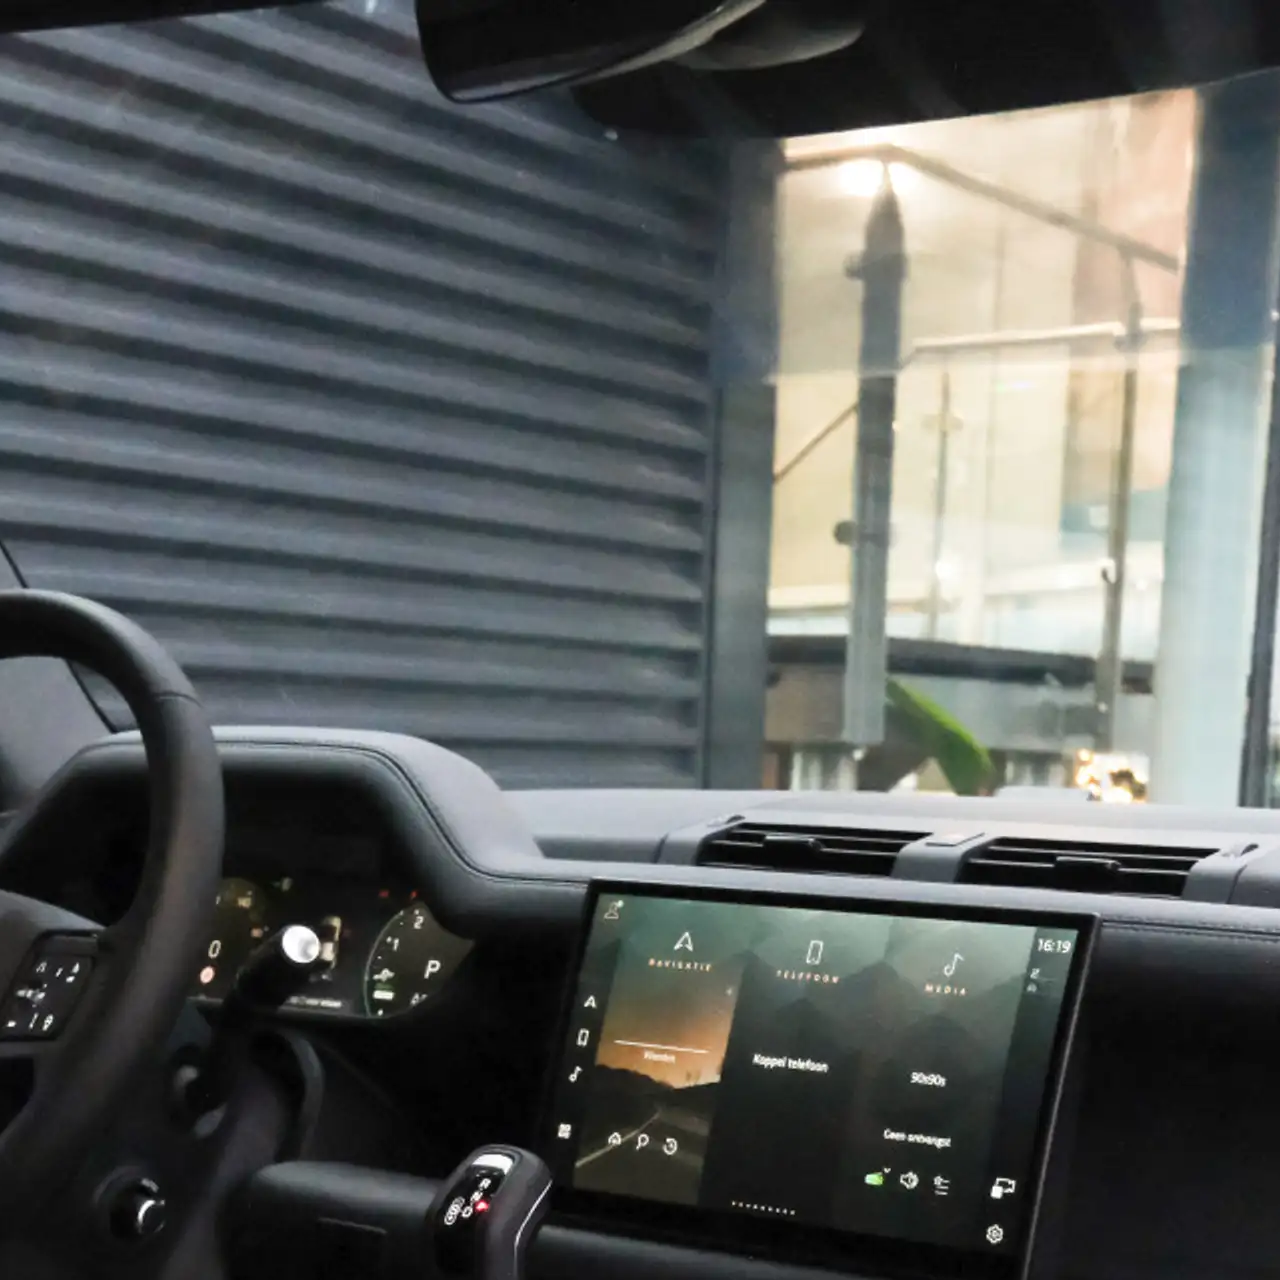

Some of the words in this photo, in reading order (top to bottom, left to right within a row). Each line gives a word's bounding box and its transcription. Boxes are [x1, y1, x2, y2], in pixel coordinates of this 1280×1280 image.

[1037, 938, 1072, 954] 16:19
[424, 960, 442, 980] P
[924, 982, 967, 997] MEDIA
[752, 1053, 787, 1069] Koppel
[788, 1057, 830, 1074] telefoon
